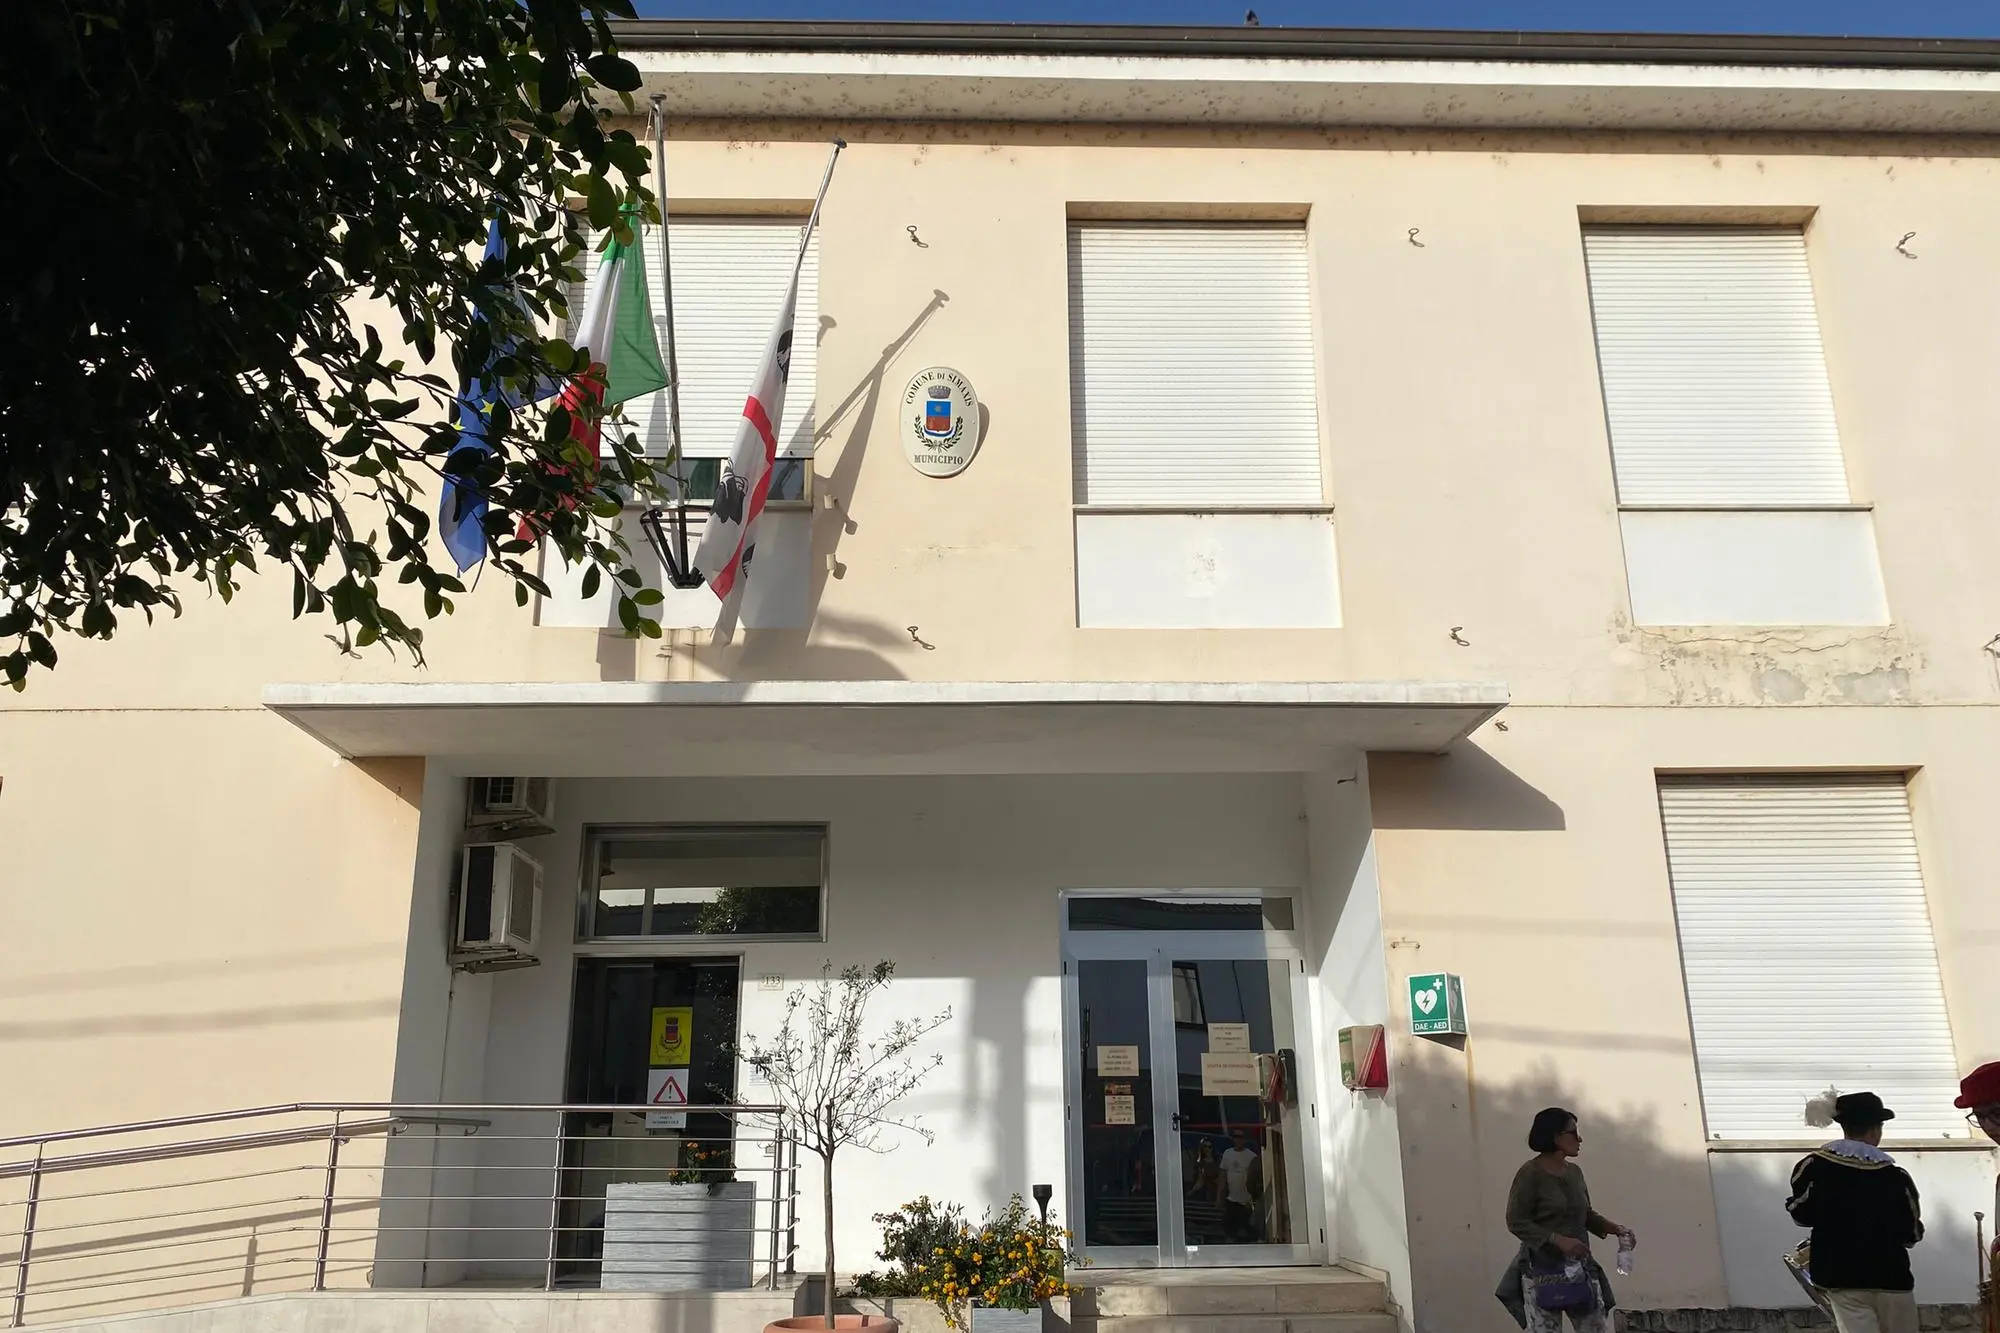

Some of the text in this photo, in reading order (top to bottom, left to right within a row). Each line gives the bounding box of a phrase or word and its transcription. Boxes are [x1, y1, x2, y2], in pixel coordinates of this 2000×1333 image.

[906, 371, 935, 404] COMUNE
[914, 455, 964, 465] MUNICIPIO
[1414, 1022, 1429, 1031] DAE
[1433, 1021, 1448, 1030] AED
